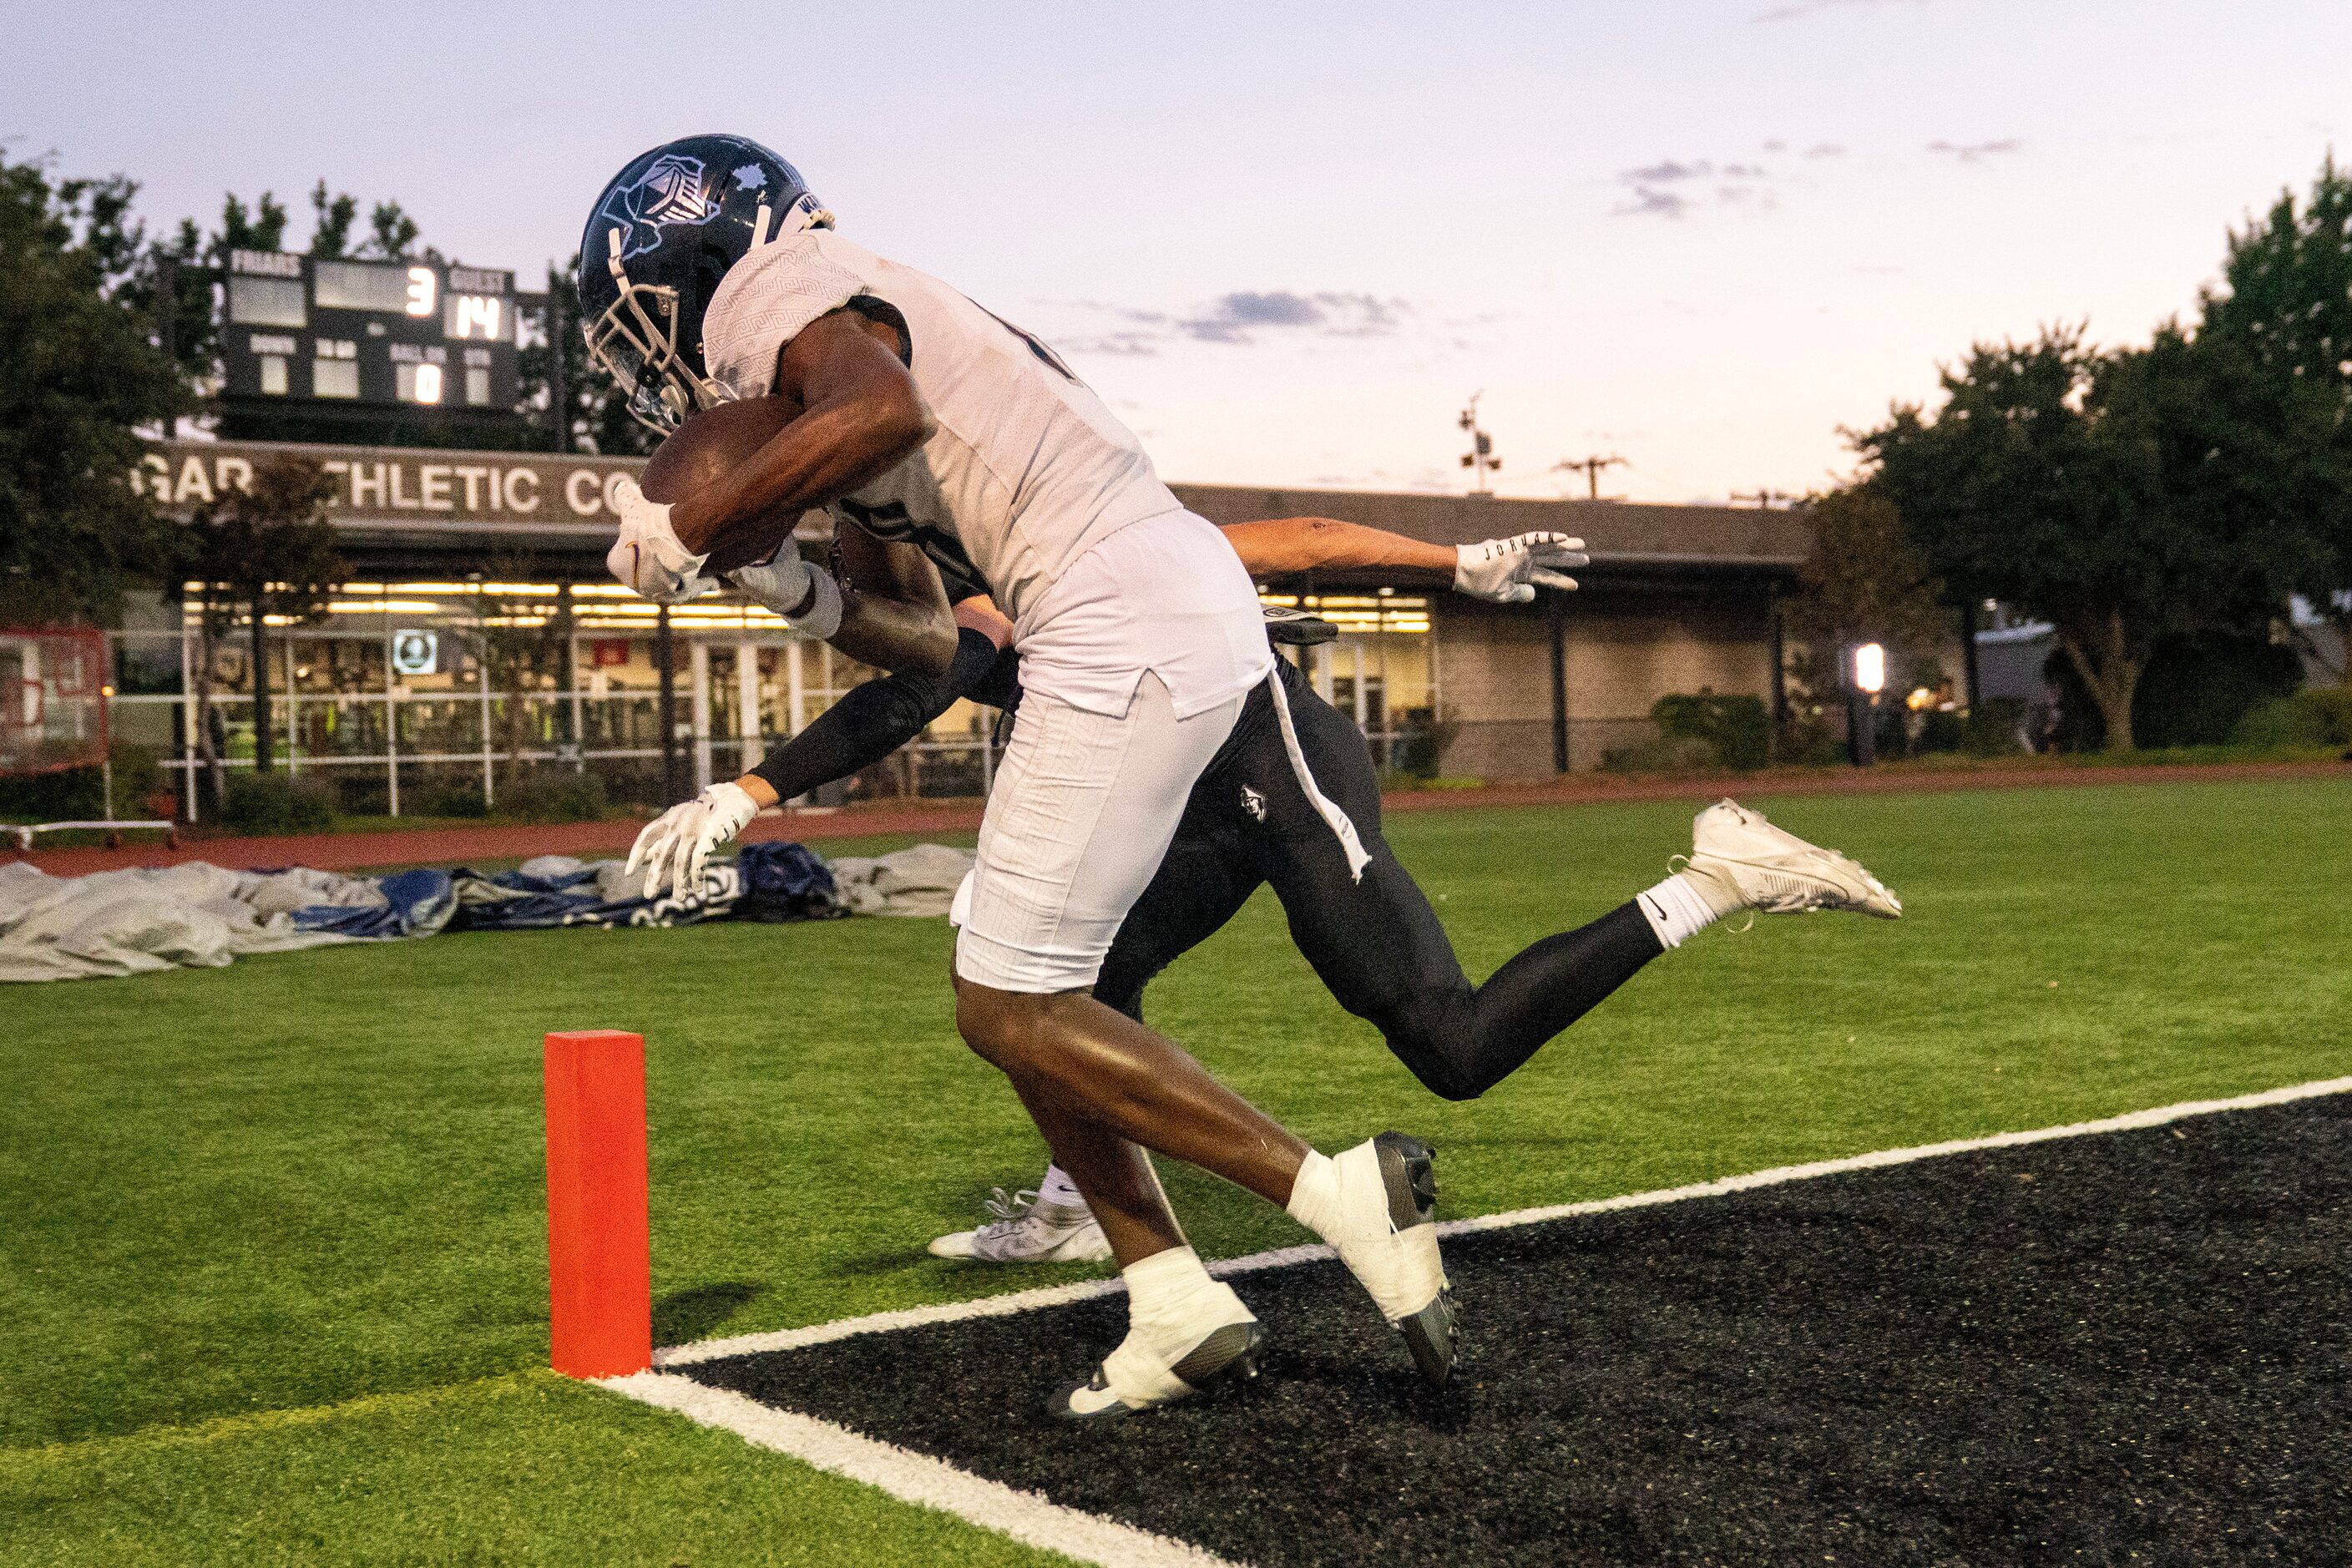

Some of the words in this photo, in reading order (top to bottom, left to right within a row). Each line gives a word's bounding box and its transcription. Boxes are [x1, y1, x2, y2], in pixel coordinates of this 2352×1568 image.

[406, 267, 435, 316] 3
[457, 296, 500, 338] 14
[416, 364, 441, 404] 0
[321, 461, 541, 513] THLETIC
